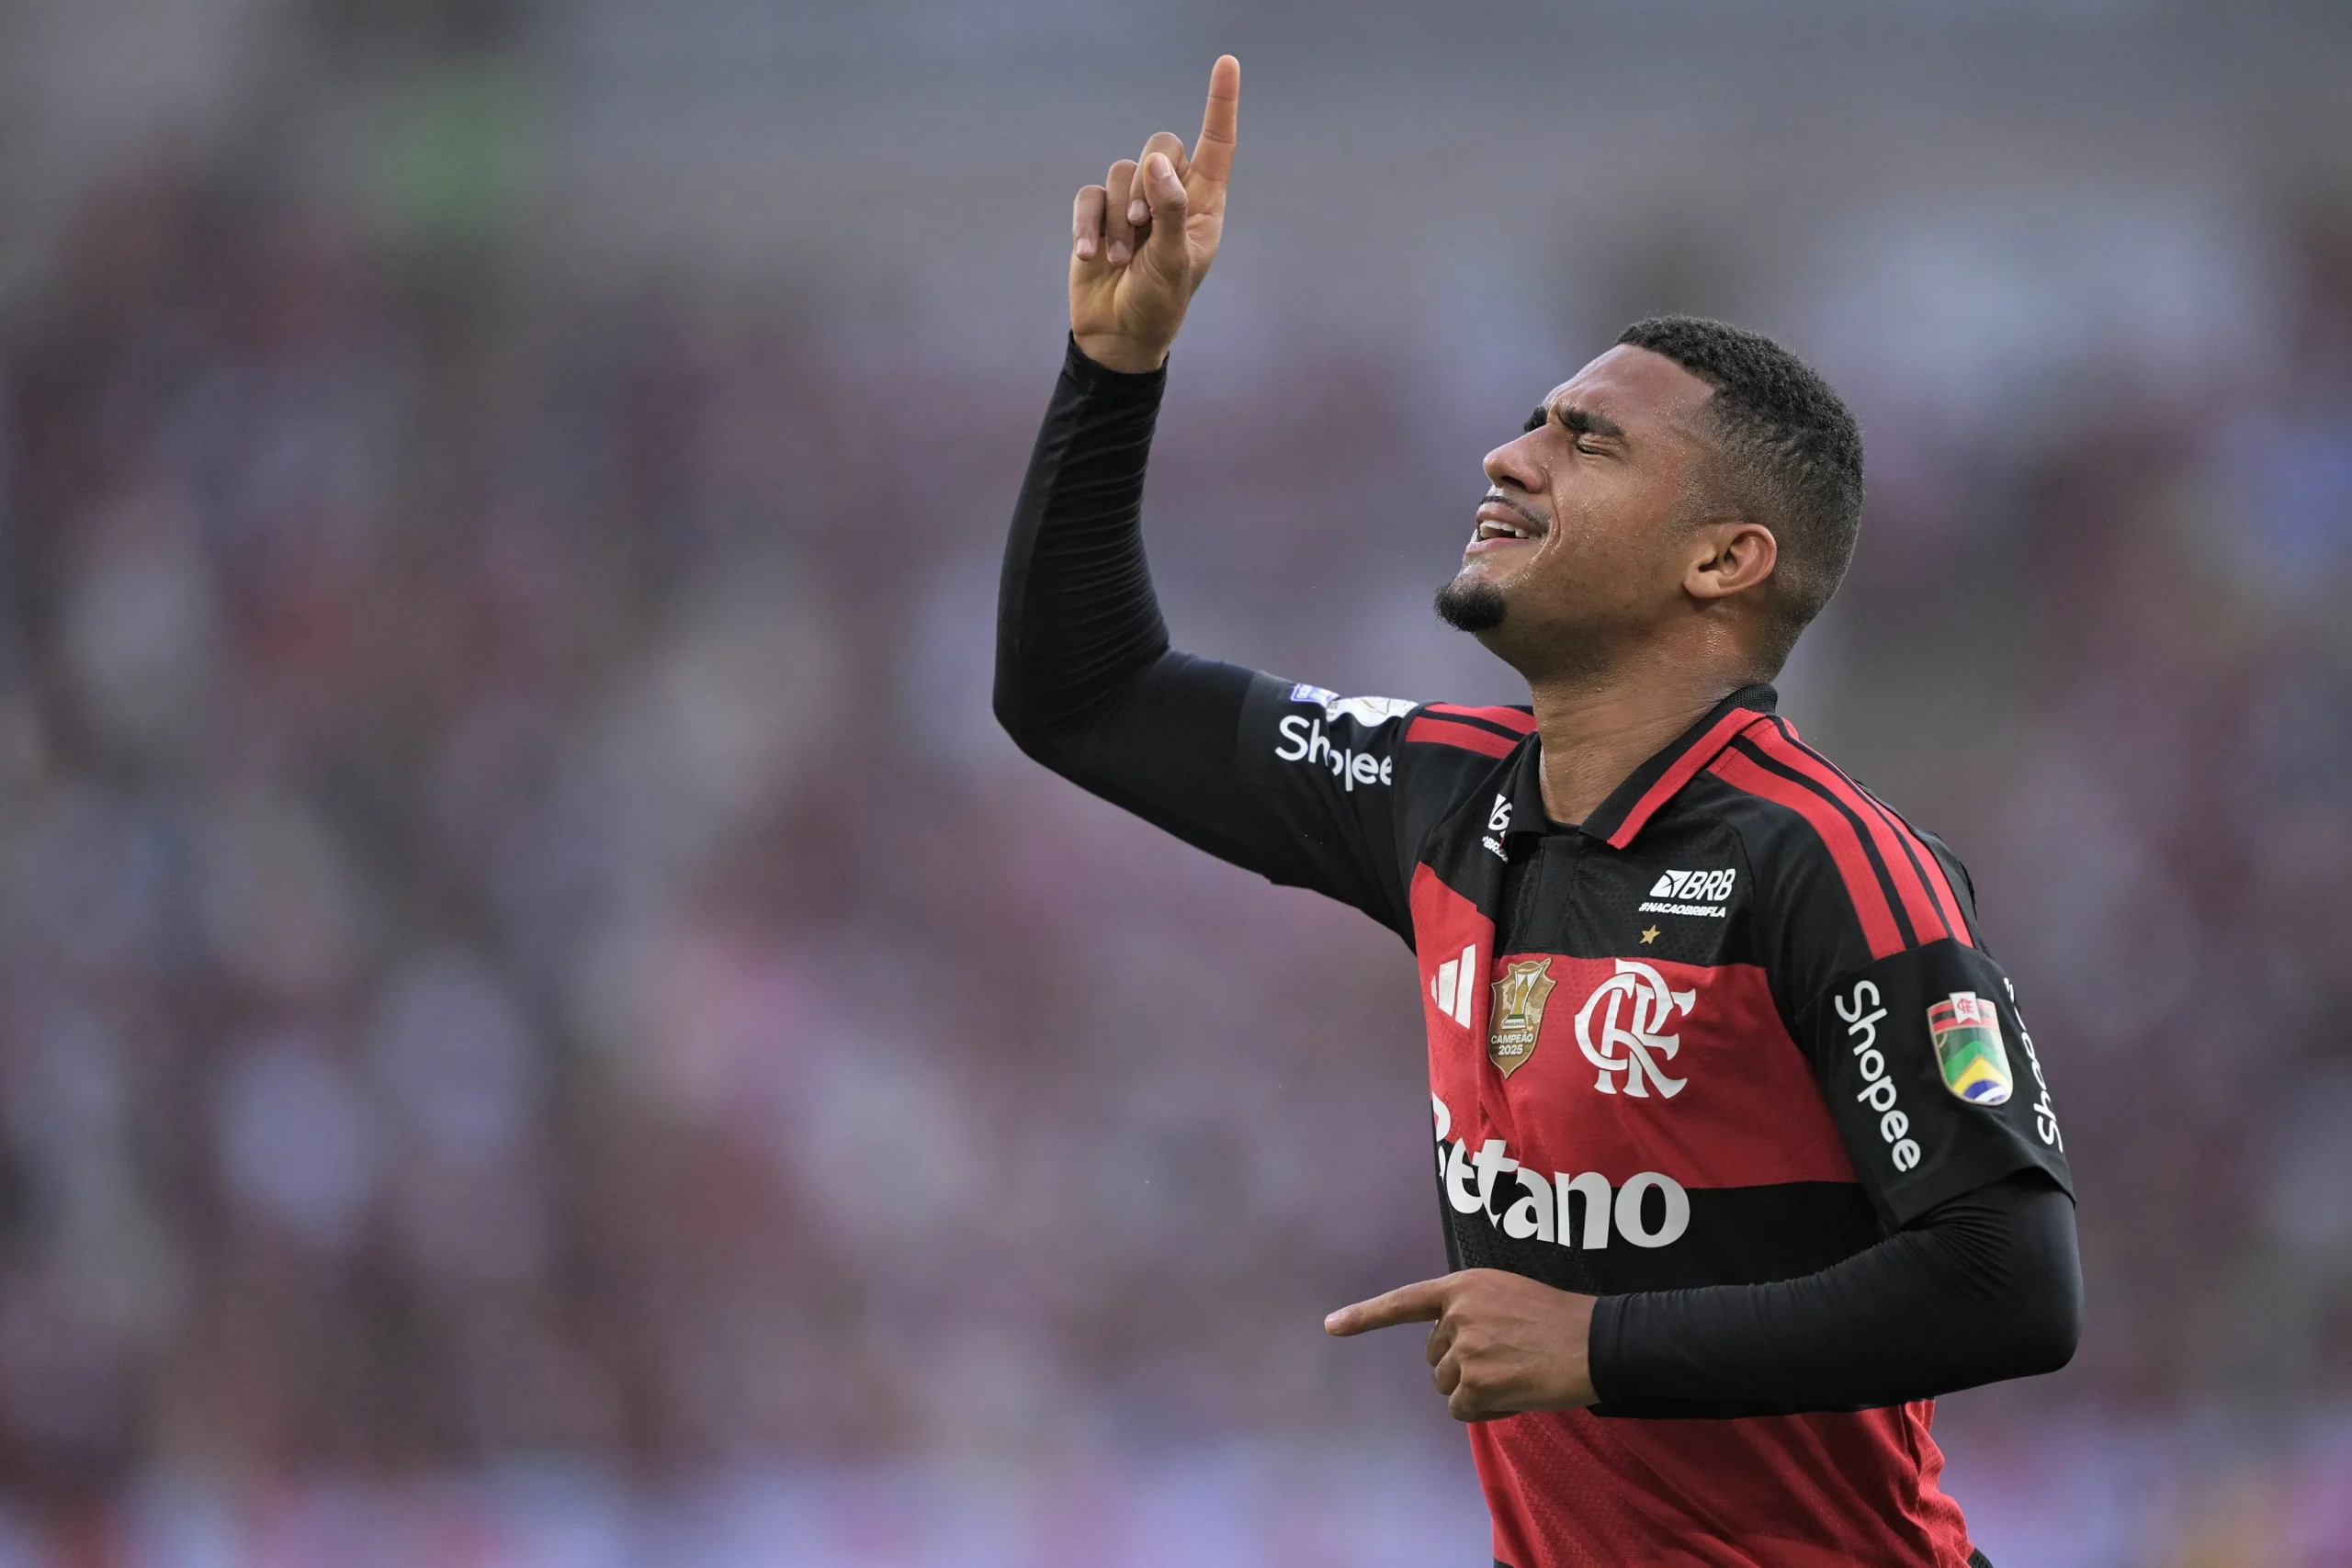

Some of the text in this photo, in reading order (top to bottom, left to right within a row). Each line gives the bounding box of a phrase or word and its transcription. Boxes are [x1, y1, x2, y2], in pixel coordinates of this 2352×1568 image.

[1679, 868, 1736, 901] BRB
[1638, 902, 1726, 918] #NACAOBRBFLA
[1490, 1031, 1533, 1044] CAMPEÃO
[1498, 1043, 1523, 1055] 2025
[1835, 980, 1921, 1172] Shopee
